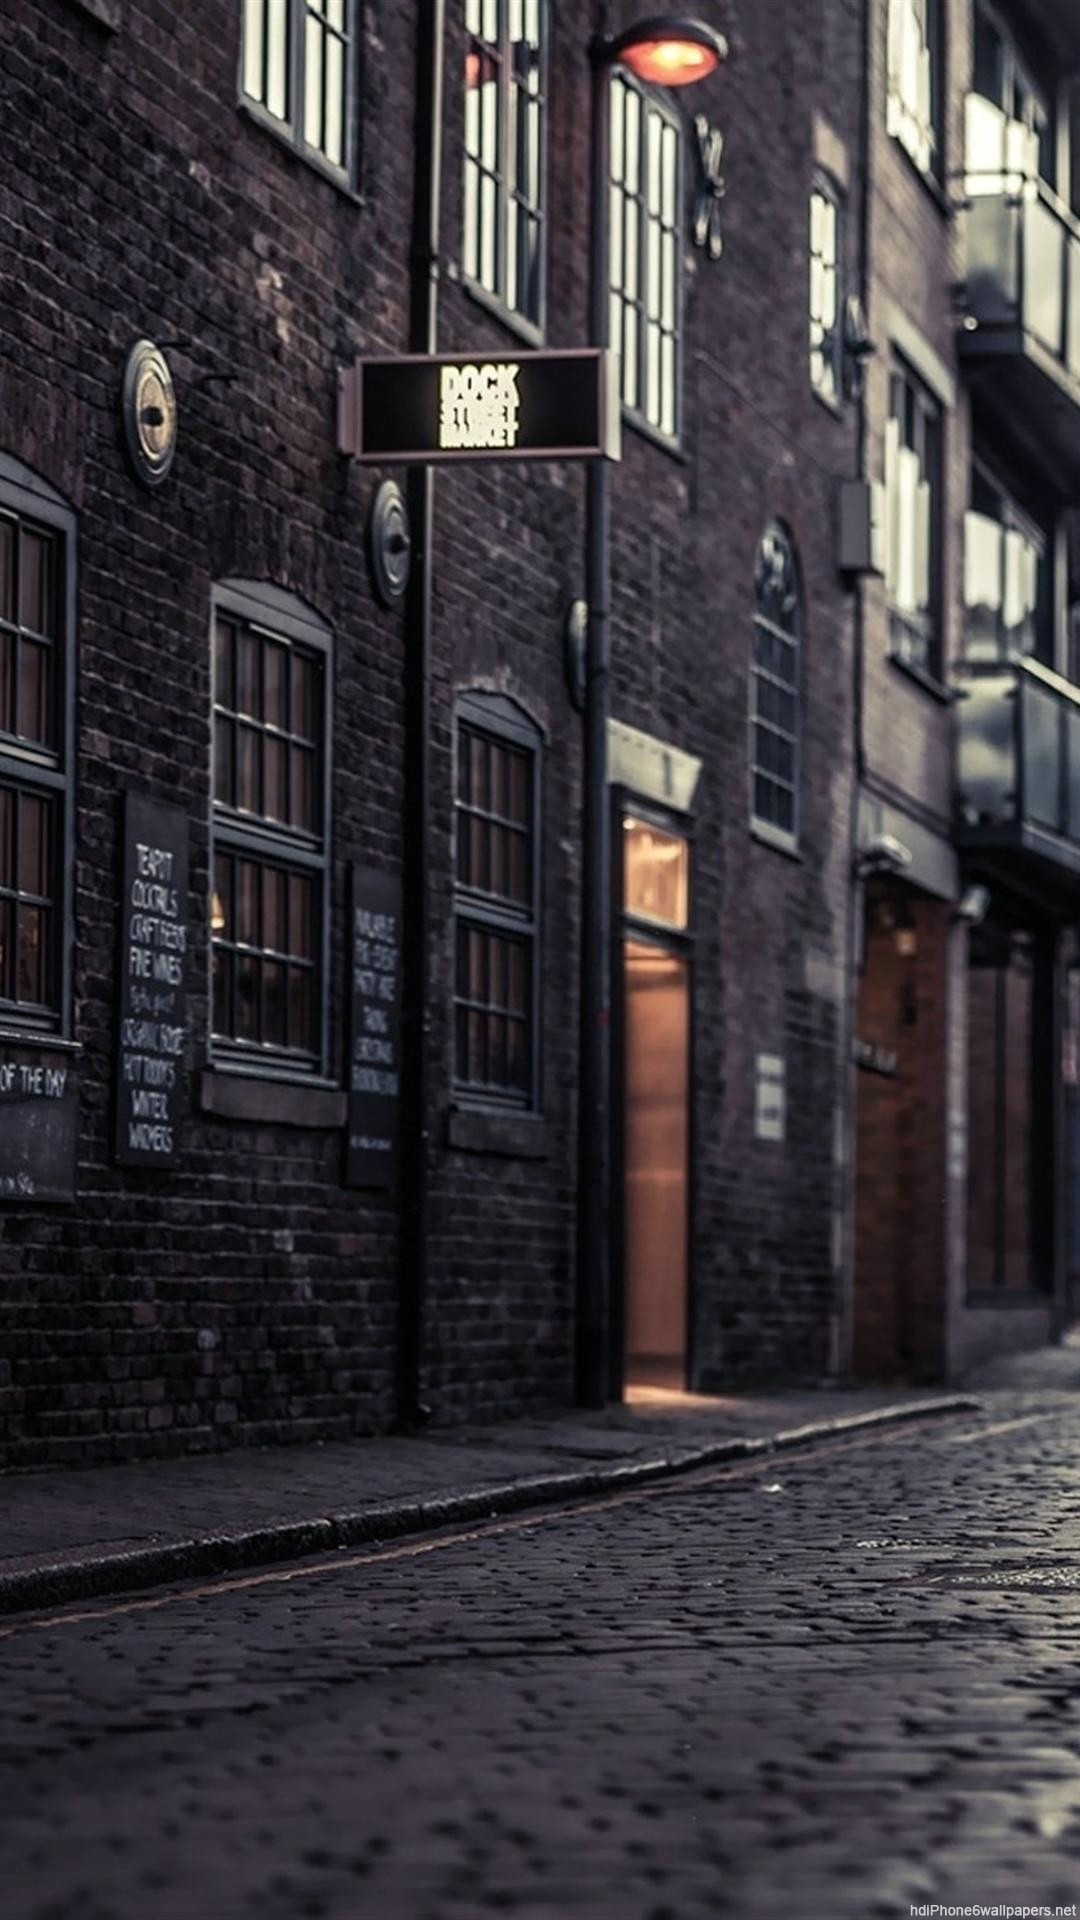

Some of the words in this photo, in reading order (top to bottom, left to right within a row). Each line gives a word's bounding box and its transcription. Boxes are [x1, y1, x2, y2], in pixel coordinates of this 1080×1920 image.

[441, 364, 520, 401] DOCK
[0, 1063, 16, 1091] OF
[20, 1065, 43, 1094] THE
[45, 1068, 67, 1098] DAY
